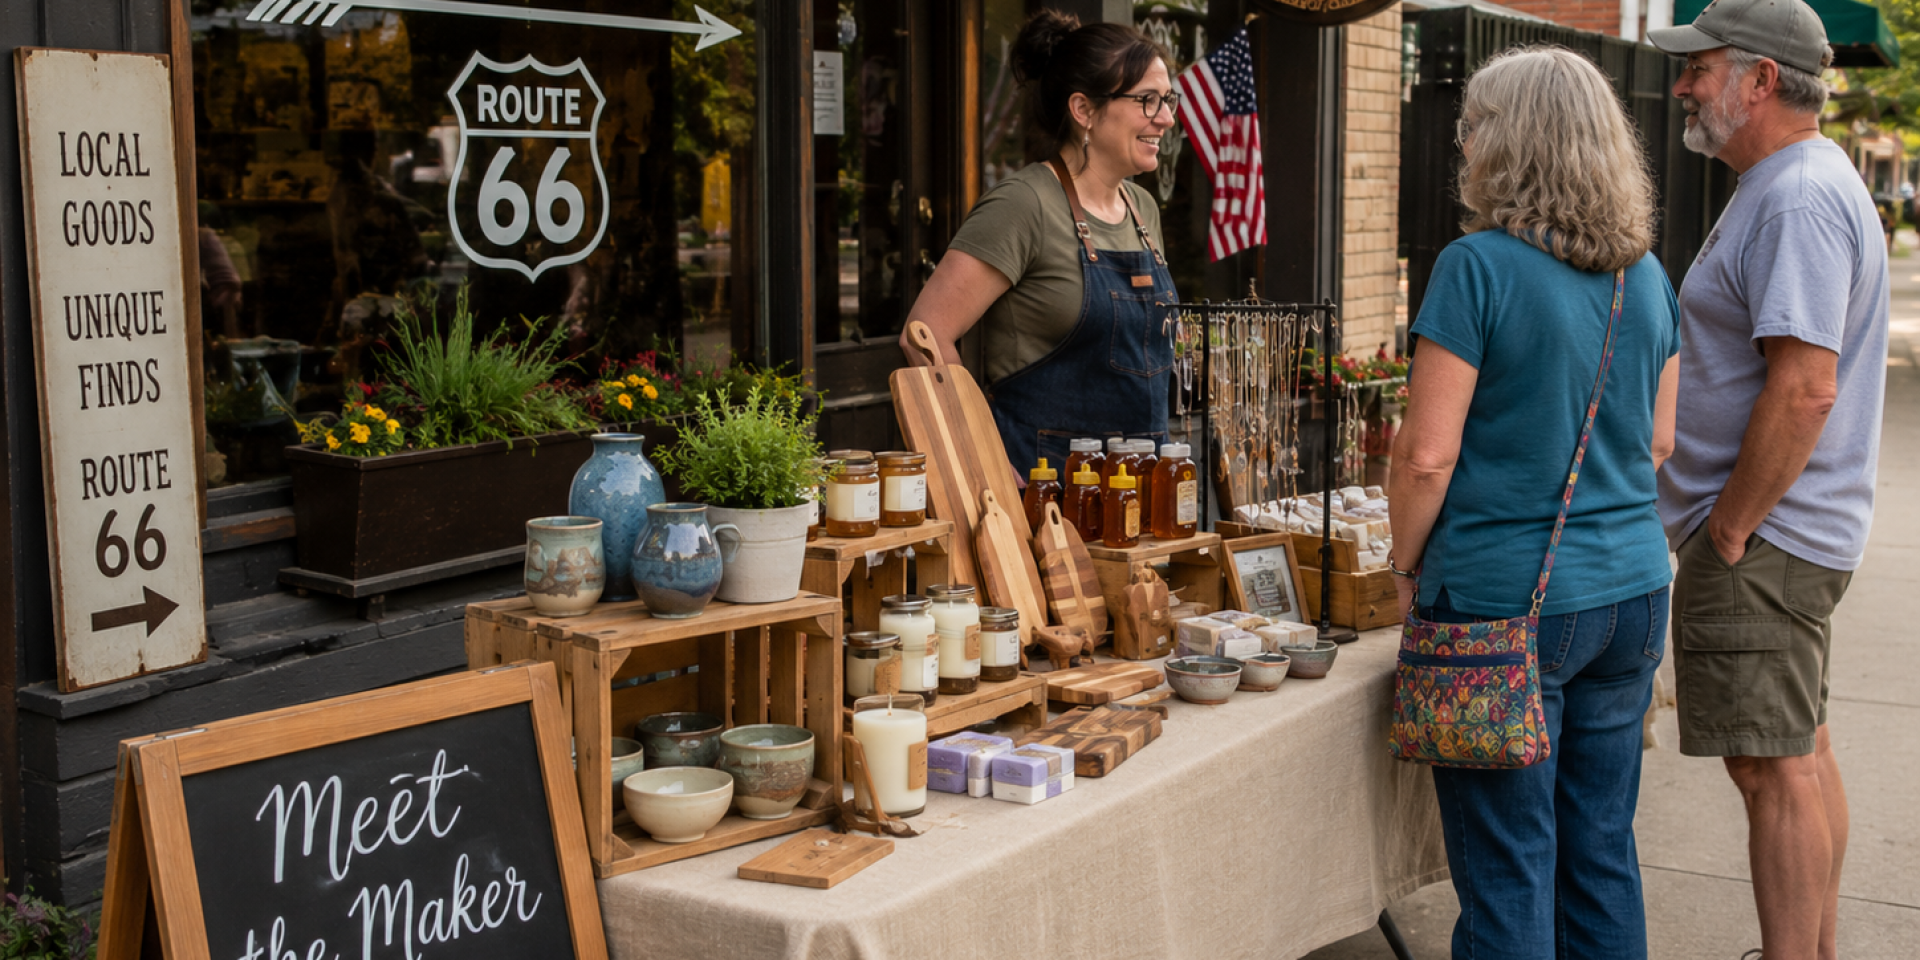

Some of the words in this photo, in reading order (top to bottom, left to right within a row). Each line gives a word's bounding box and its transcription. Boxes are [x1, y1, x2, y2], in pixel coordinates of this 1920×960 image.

[477, 84, 581, 124] ROUTE
[57, 131, 151, 178] LOCAL
[478, 146, 585, 246] 66
[62, 200, 155, 248] GOODS
[62, 290, 167, 342] UNIQUE
[78, 358, 161, 411] FINDS
[80, 448, 172, 501] ROUTE
[95, 503, 167, 578] 66
[347, 853, 543, 960] Maker
